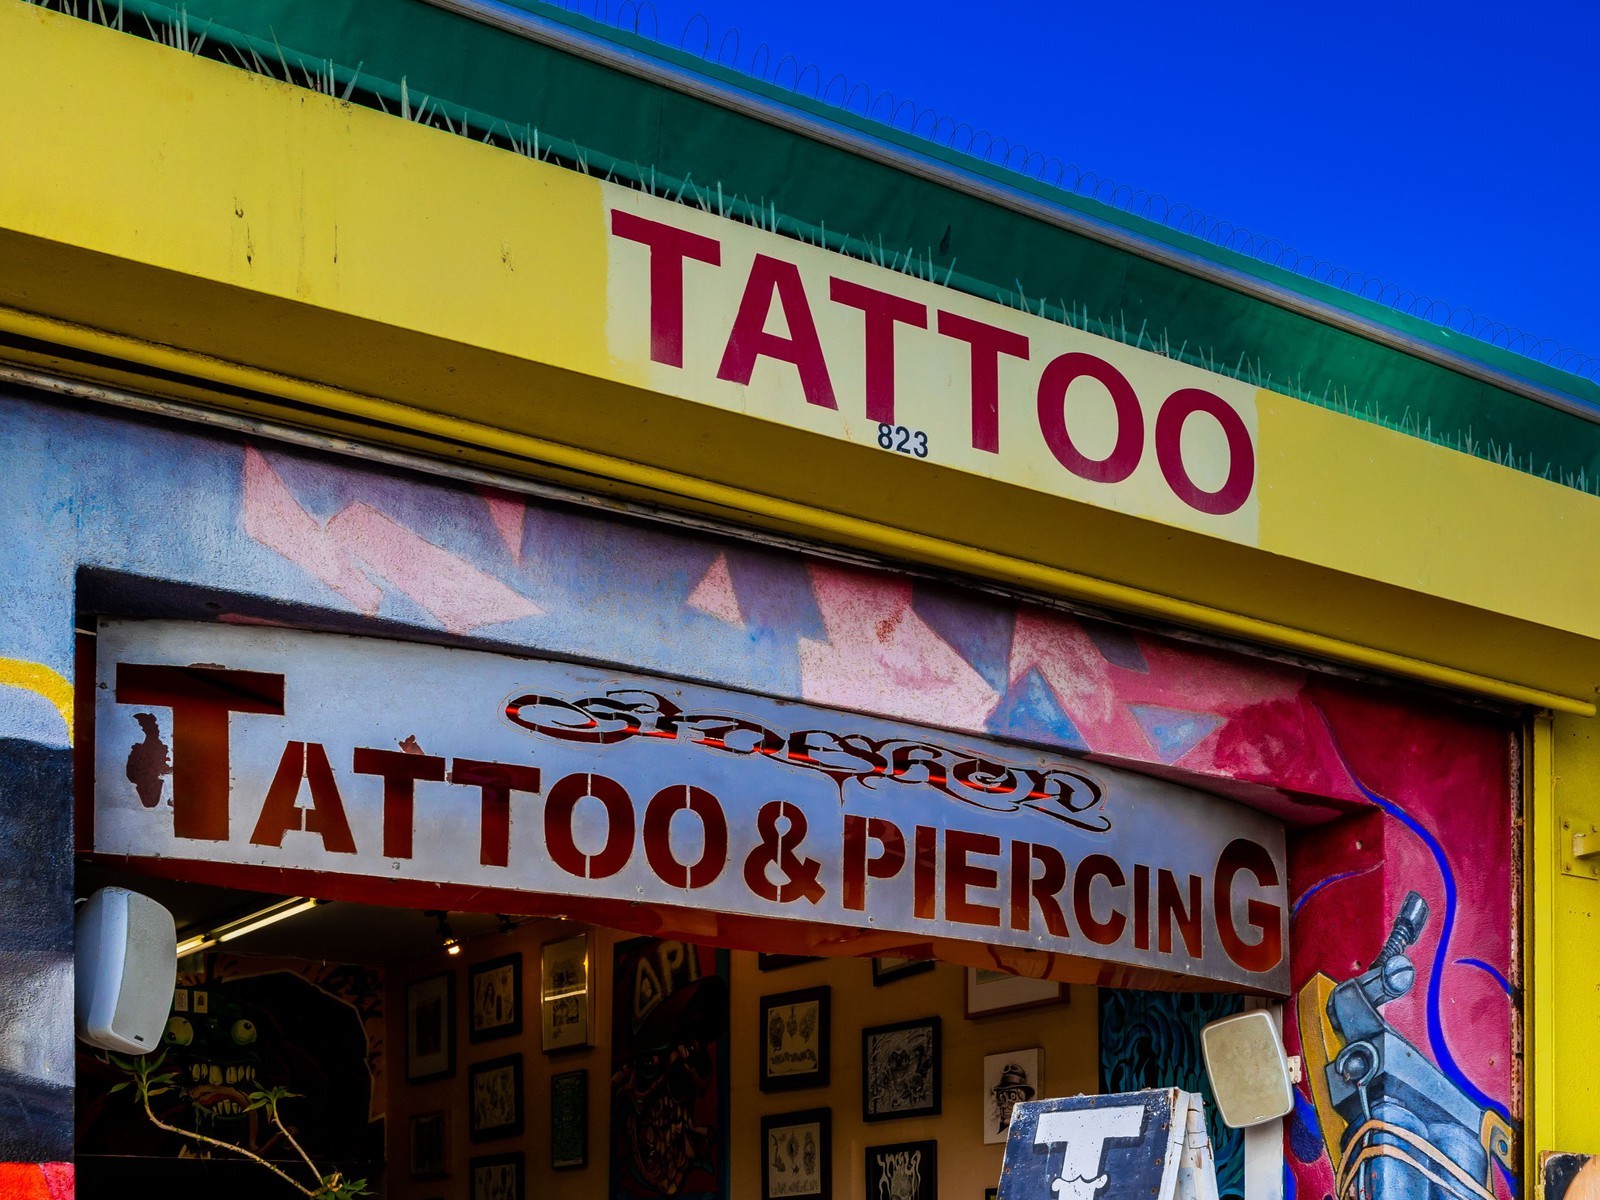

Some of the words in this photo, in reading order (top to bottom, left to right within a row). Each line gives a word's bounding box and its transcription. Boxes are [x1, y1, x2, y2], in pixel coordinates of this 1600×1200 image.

[611, 208, 1255, 516] TATTOO
[877, 423, 929, 458] 823
[115, 662, 728, 890] TATTOO
[742, 800, 826, 905] &
[842, 812, 1283, 973] PIERCING
